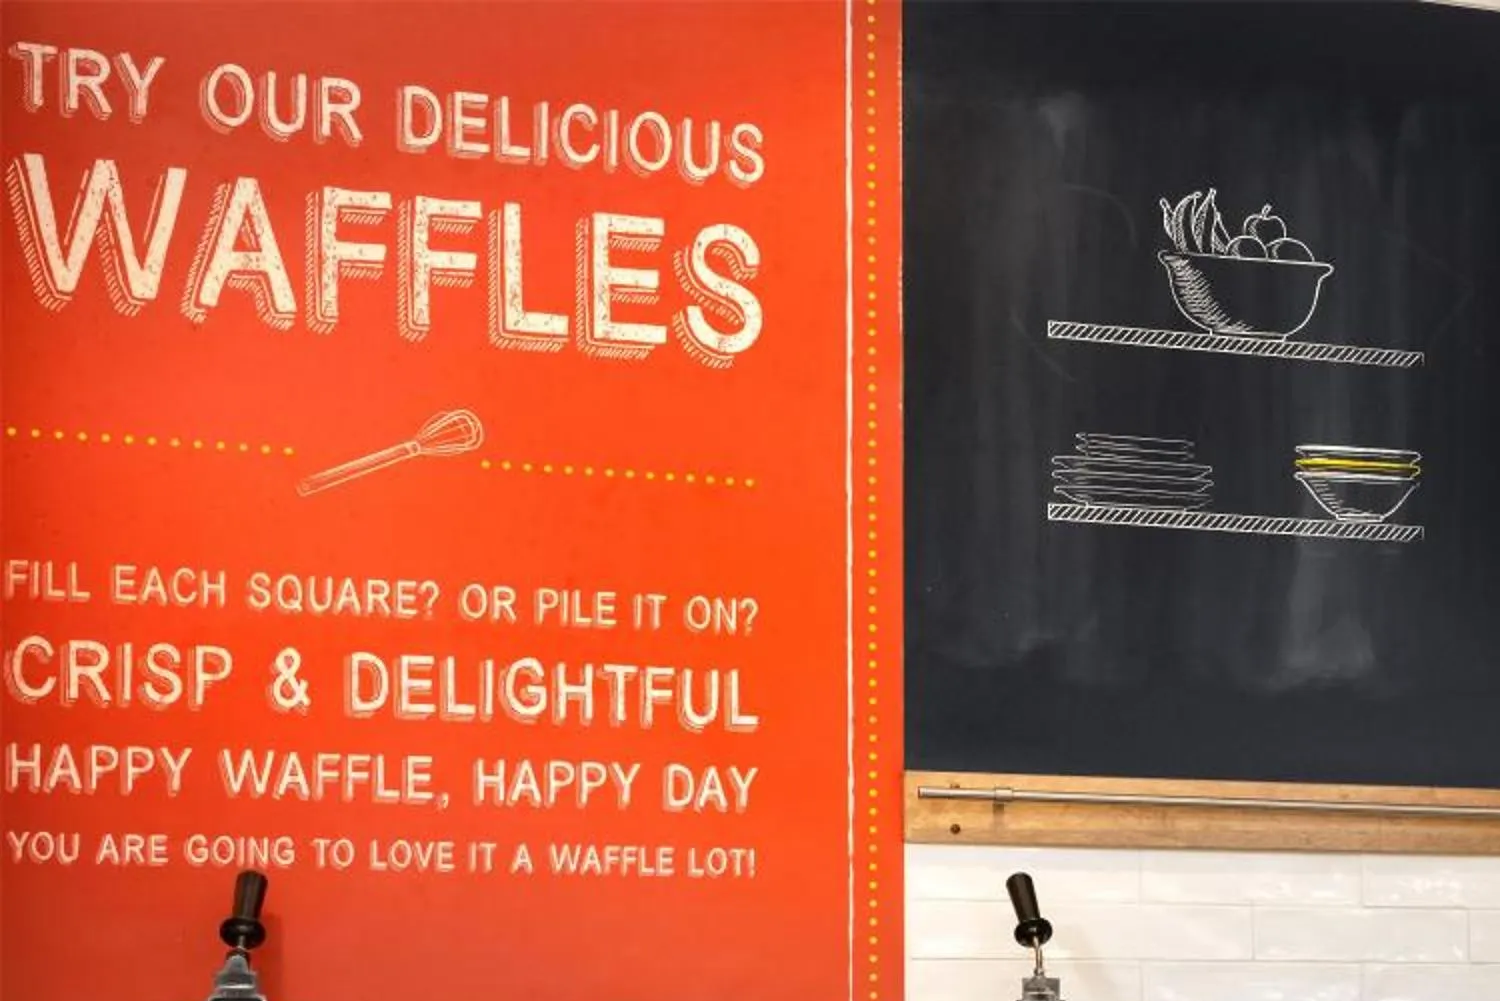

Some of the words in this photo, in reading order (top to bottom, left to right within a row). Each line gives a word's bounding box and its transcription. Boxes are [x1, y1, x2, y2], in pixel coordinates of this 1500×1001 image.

[9, 41, 165, 124] TRY
[200, 63, 363, 148] OUR
[397, 84, 766, 189] DELICIOUS
[6, 152, 764, 369] WAFFLES
[4, 559, 91, 600] FILL
[111, 563, 227, 608] EACH
[248, 571, 440, 620] SQUARE?
[459, 583, 517, 626] OR
[533, 587, 617, 629] PILE
[631, 593, 667, 630] IT
[683, 595, 759, 636] ON?
[5, 635, 233, 712] CRISP
[269, 646, 312, 717] &
[343, 650, 760, 734] DELIGHTFUL
[5, 742, 193, 797] HAPPY
[219, 748, 450, 809] WAFFLE,
[473, 757, 641, 811] HAPPY
[662, 763, 759, 814] DAY
[7, 831, 80, 865] YOU
[95, 833, 169, 867] ARE
[184, 834, 296, 868] GOING
[312, 837, 356, 869] TO
[369, 838, 455, 872] LOVE
[468, 842, 497, 873] IT
[510, 844, 535, 876] A
[549, 843, 675, 878] WAFFLE
[688, 846, 757, 879] LOT!
